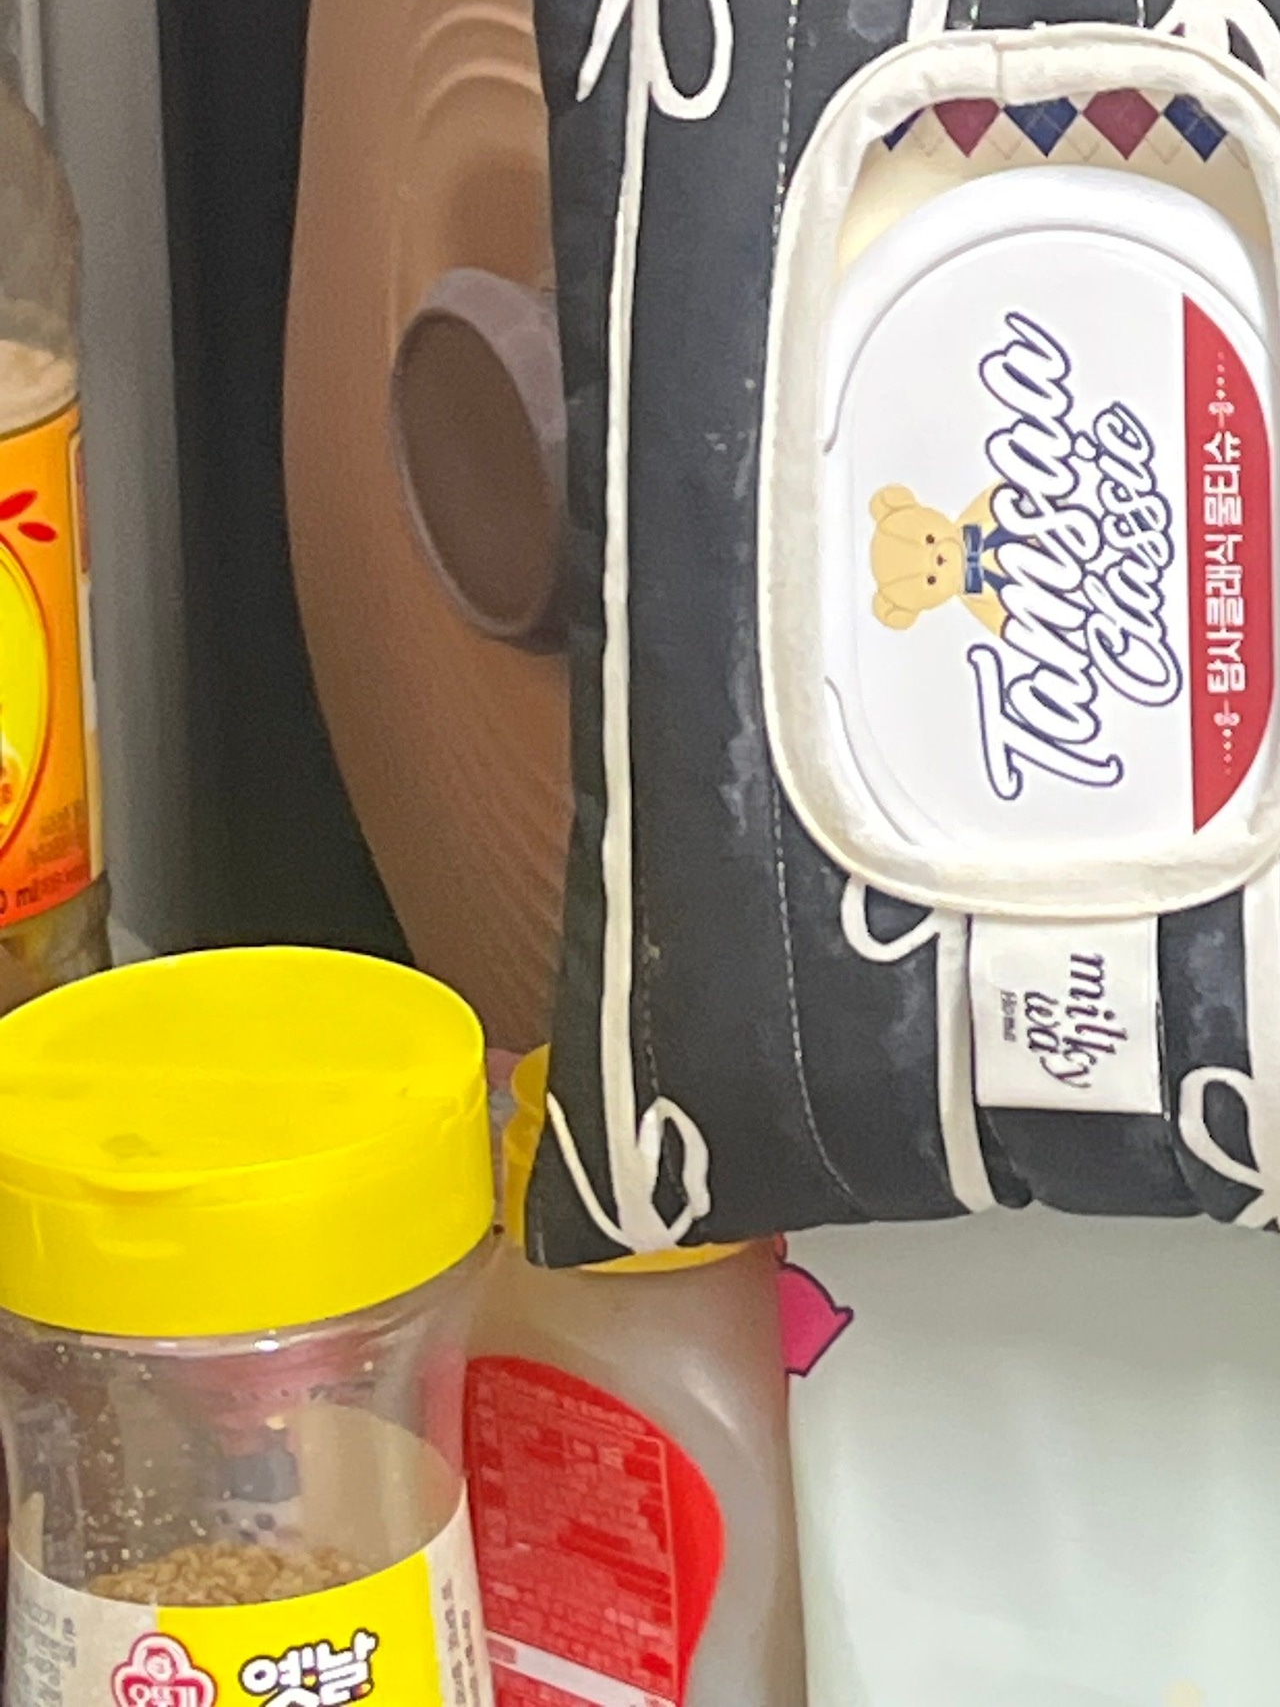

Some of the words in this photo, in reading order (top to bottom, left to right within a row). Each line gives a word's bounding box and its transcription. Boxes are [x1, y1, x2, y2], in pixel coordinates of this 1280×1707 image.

[966, 311, 1123, 800] Tamsaa
[1070, 401, 1183, 706] Classic
[1202, 430, 1243, 527] 물티슈
[1205, 533, 1248, 694] 탐사클래식
[1039, 953, 1128, 1088] milky
